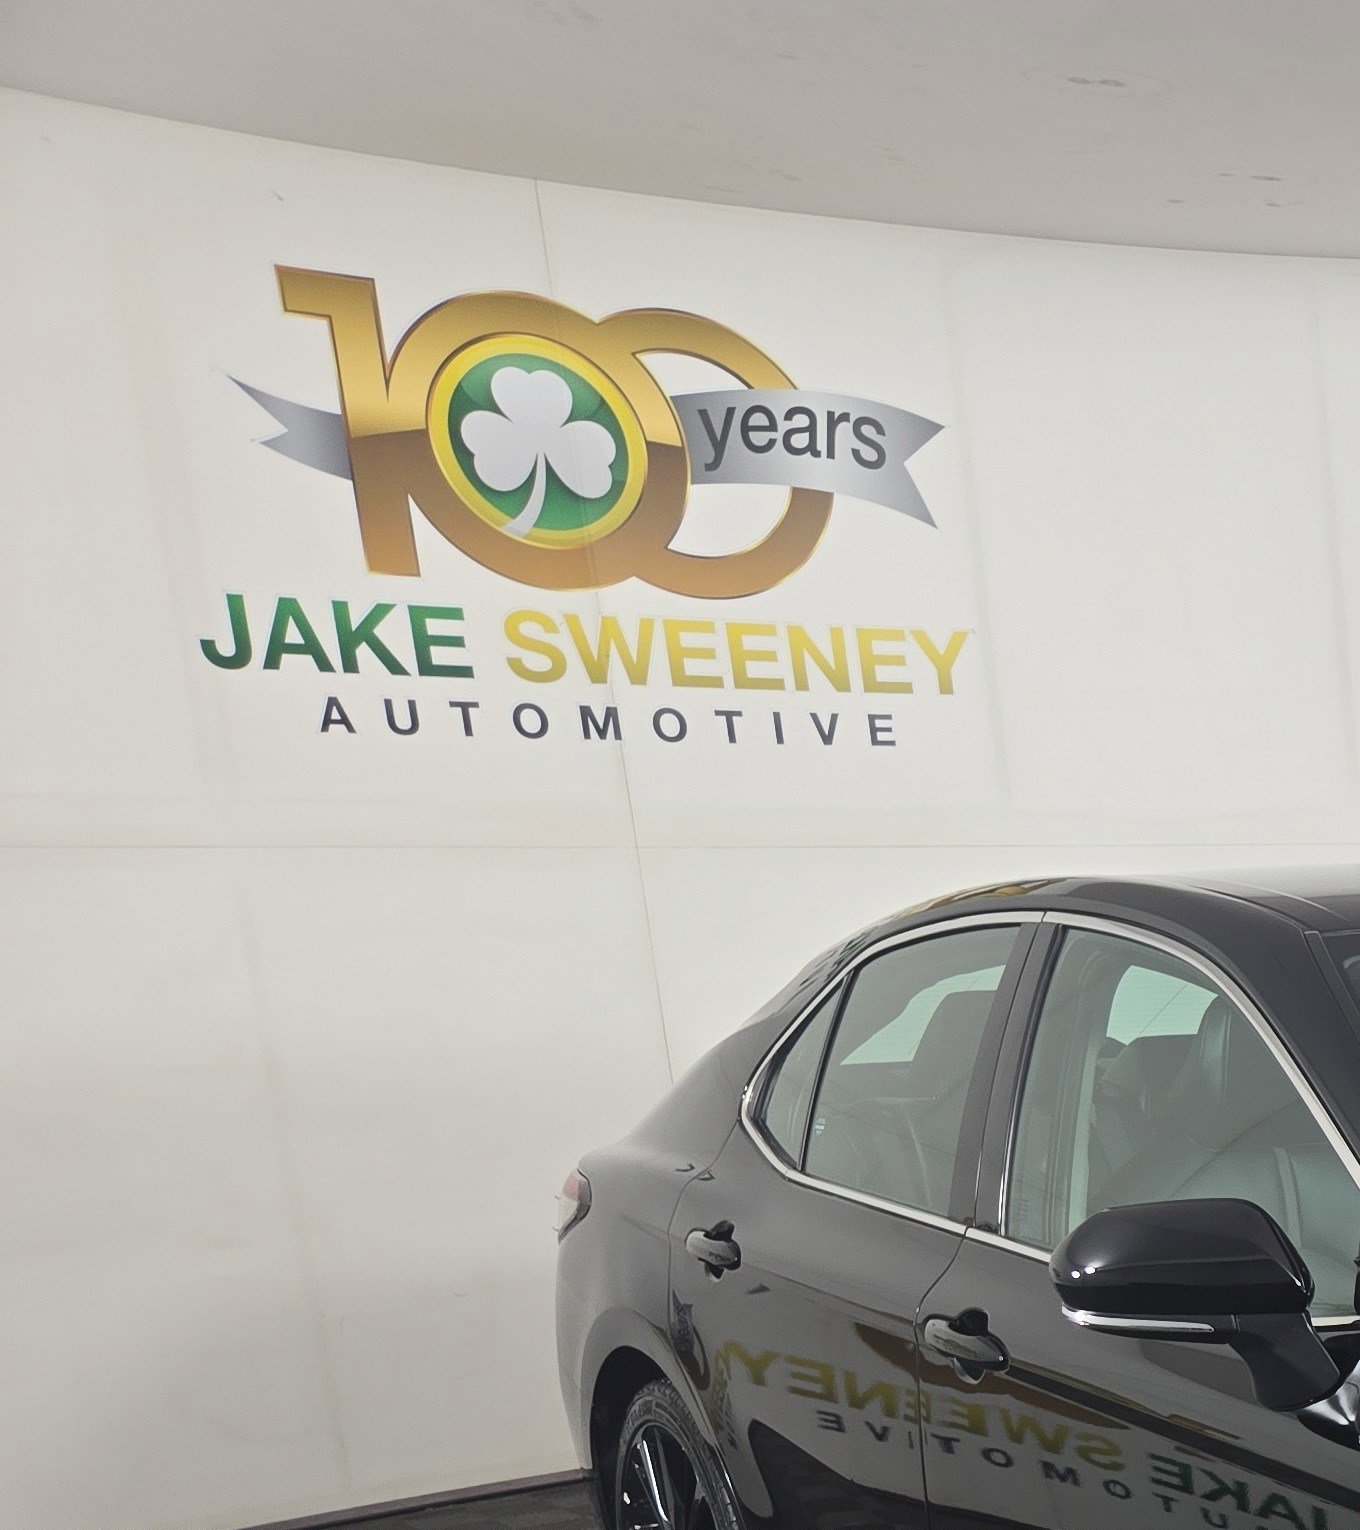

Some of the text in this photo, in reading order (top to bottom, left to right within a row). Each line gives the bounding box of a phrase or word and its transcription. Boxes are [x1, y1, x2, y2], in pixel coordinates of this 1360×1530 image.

[697, 400, 887, 471] years
[200, 592, 968, 696] JAKE SWEENEY
[320, 695, 897, 746] AUTOMOTIVE
